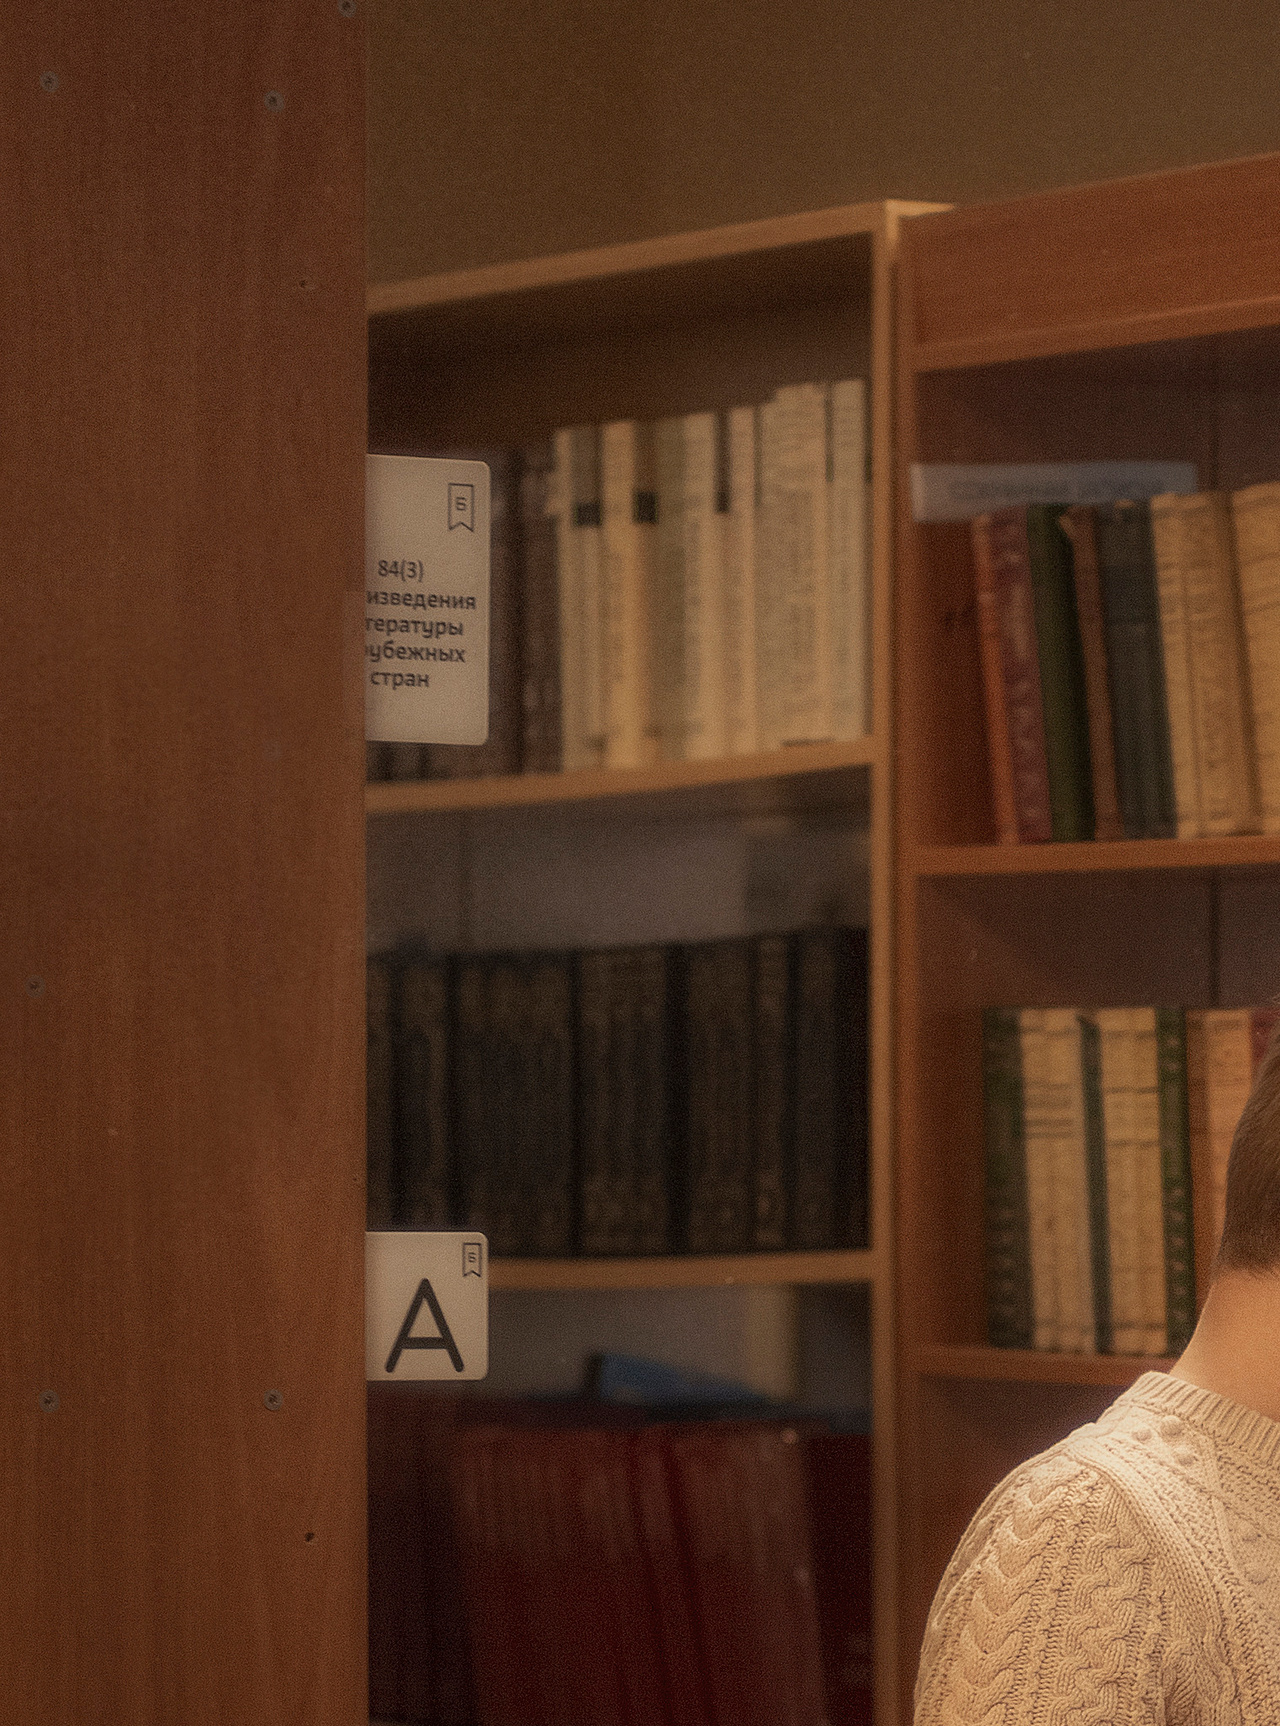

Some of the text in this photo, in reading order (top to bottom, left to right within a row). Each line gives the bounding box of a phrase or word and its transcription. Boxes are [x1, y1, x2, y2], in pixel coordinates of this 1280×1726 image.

[377, 558, 424, 583] 84(3)
[370, 671, 430, 691] стран
[385, 1278, 465, 1373] А
